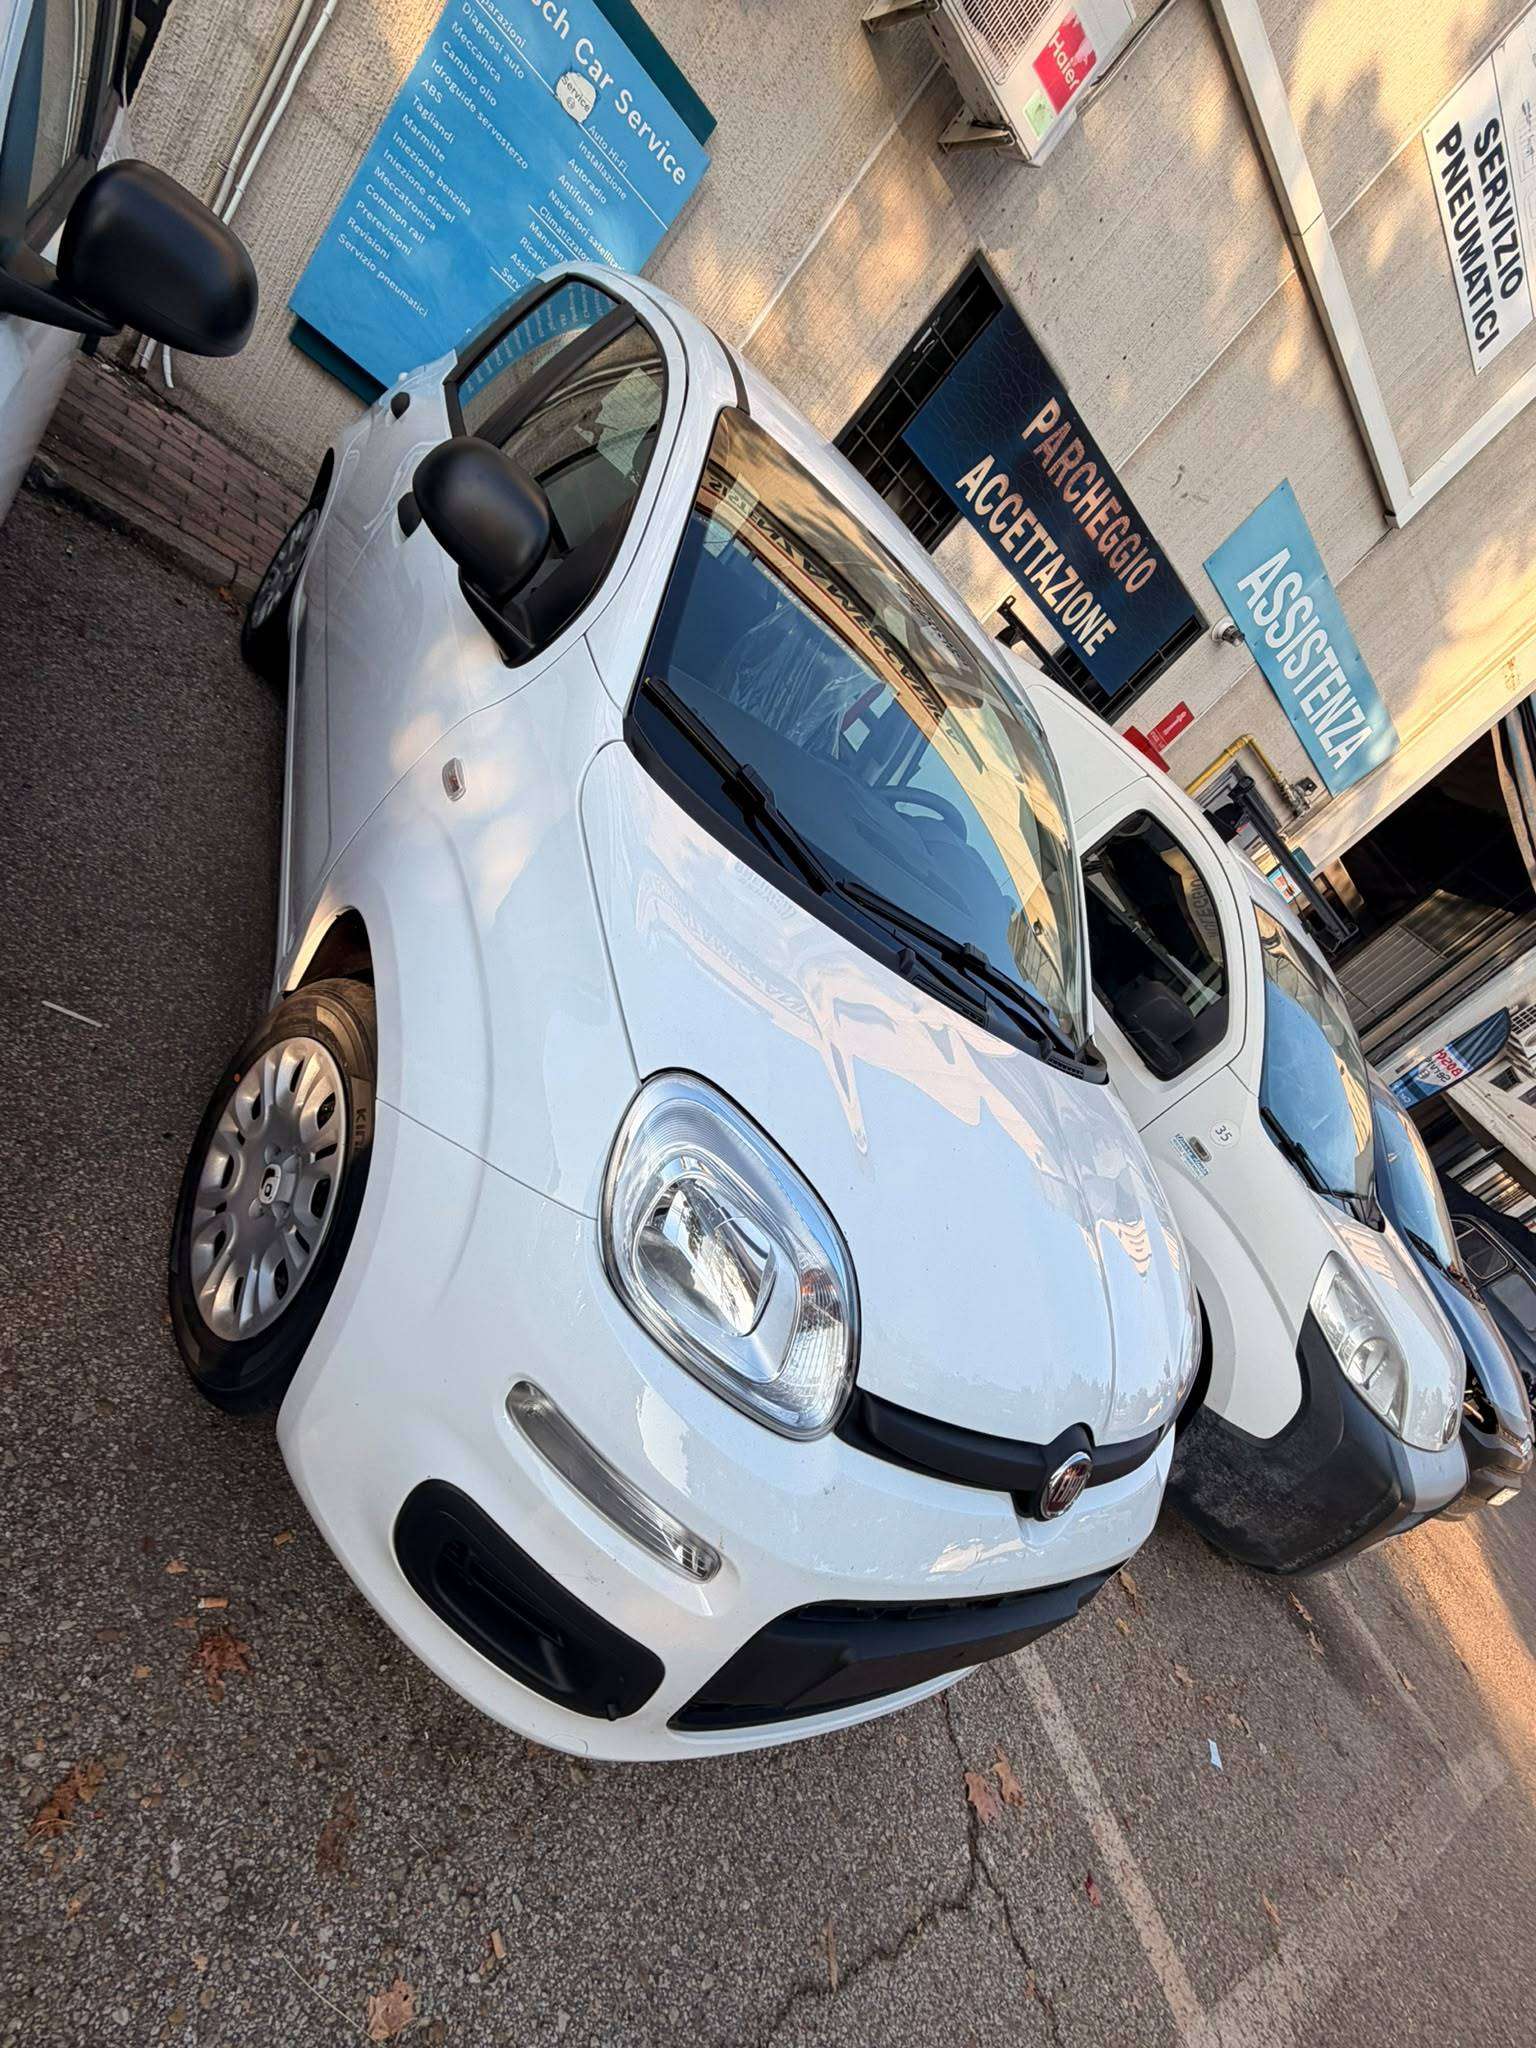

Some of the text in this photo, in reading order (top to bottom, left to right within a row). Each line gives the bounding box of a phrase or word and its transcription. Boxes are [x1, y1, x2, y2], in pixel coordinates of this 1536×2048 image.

[450, 22, 501, 82] Meccanica
[461, 3, 525, 79] Diagnosi auto
[1048, 30, 1079, 89] Haier
[420, 81, 443, 103] ABS
[442, 42, 497, 106] Cambio olio
[532, 0, 686, 184] ch Car Service
[562, 76, 591, 112] Service
[400, 114, 445, 162] Marmitte
[412, 95, 456, 144] Tagliandi
[476, 112, 529, 169] servosterzo
[588, 125, 607, 149] Auto
[373, 166, 437, 230] Meccatronica
[382, 149, 456, 223] Iniezione diesel
[392, 132, 471, 215] Iniezione benzina
[558, 175, 594, 215] Antifurto
[567, 159, 606, 203] Autoradio
[578, 141, 626, 200] Installazione
[346, 216, 391, 260] Revisioni
[355, 200, 413, 255] Prerevisioni
[365, 185, 425, 243] Common rail
[548, 189, 590, 236] Navigatori
[1436, 122, 1501, 352] PNEUMATICI
[1474, 118, 1522, 300] SERVIZIO
[337, 234, 428, 317] Servizio pneumatici
[1022, 397, 1157, 593] PARCHEGGIO
[956, 454, 1117, 657] ACCETTAZIONE
[1238, 548, 1373, 770] ASSISTENZA
[1215, 1125, 1234, 1142] 35
